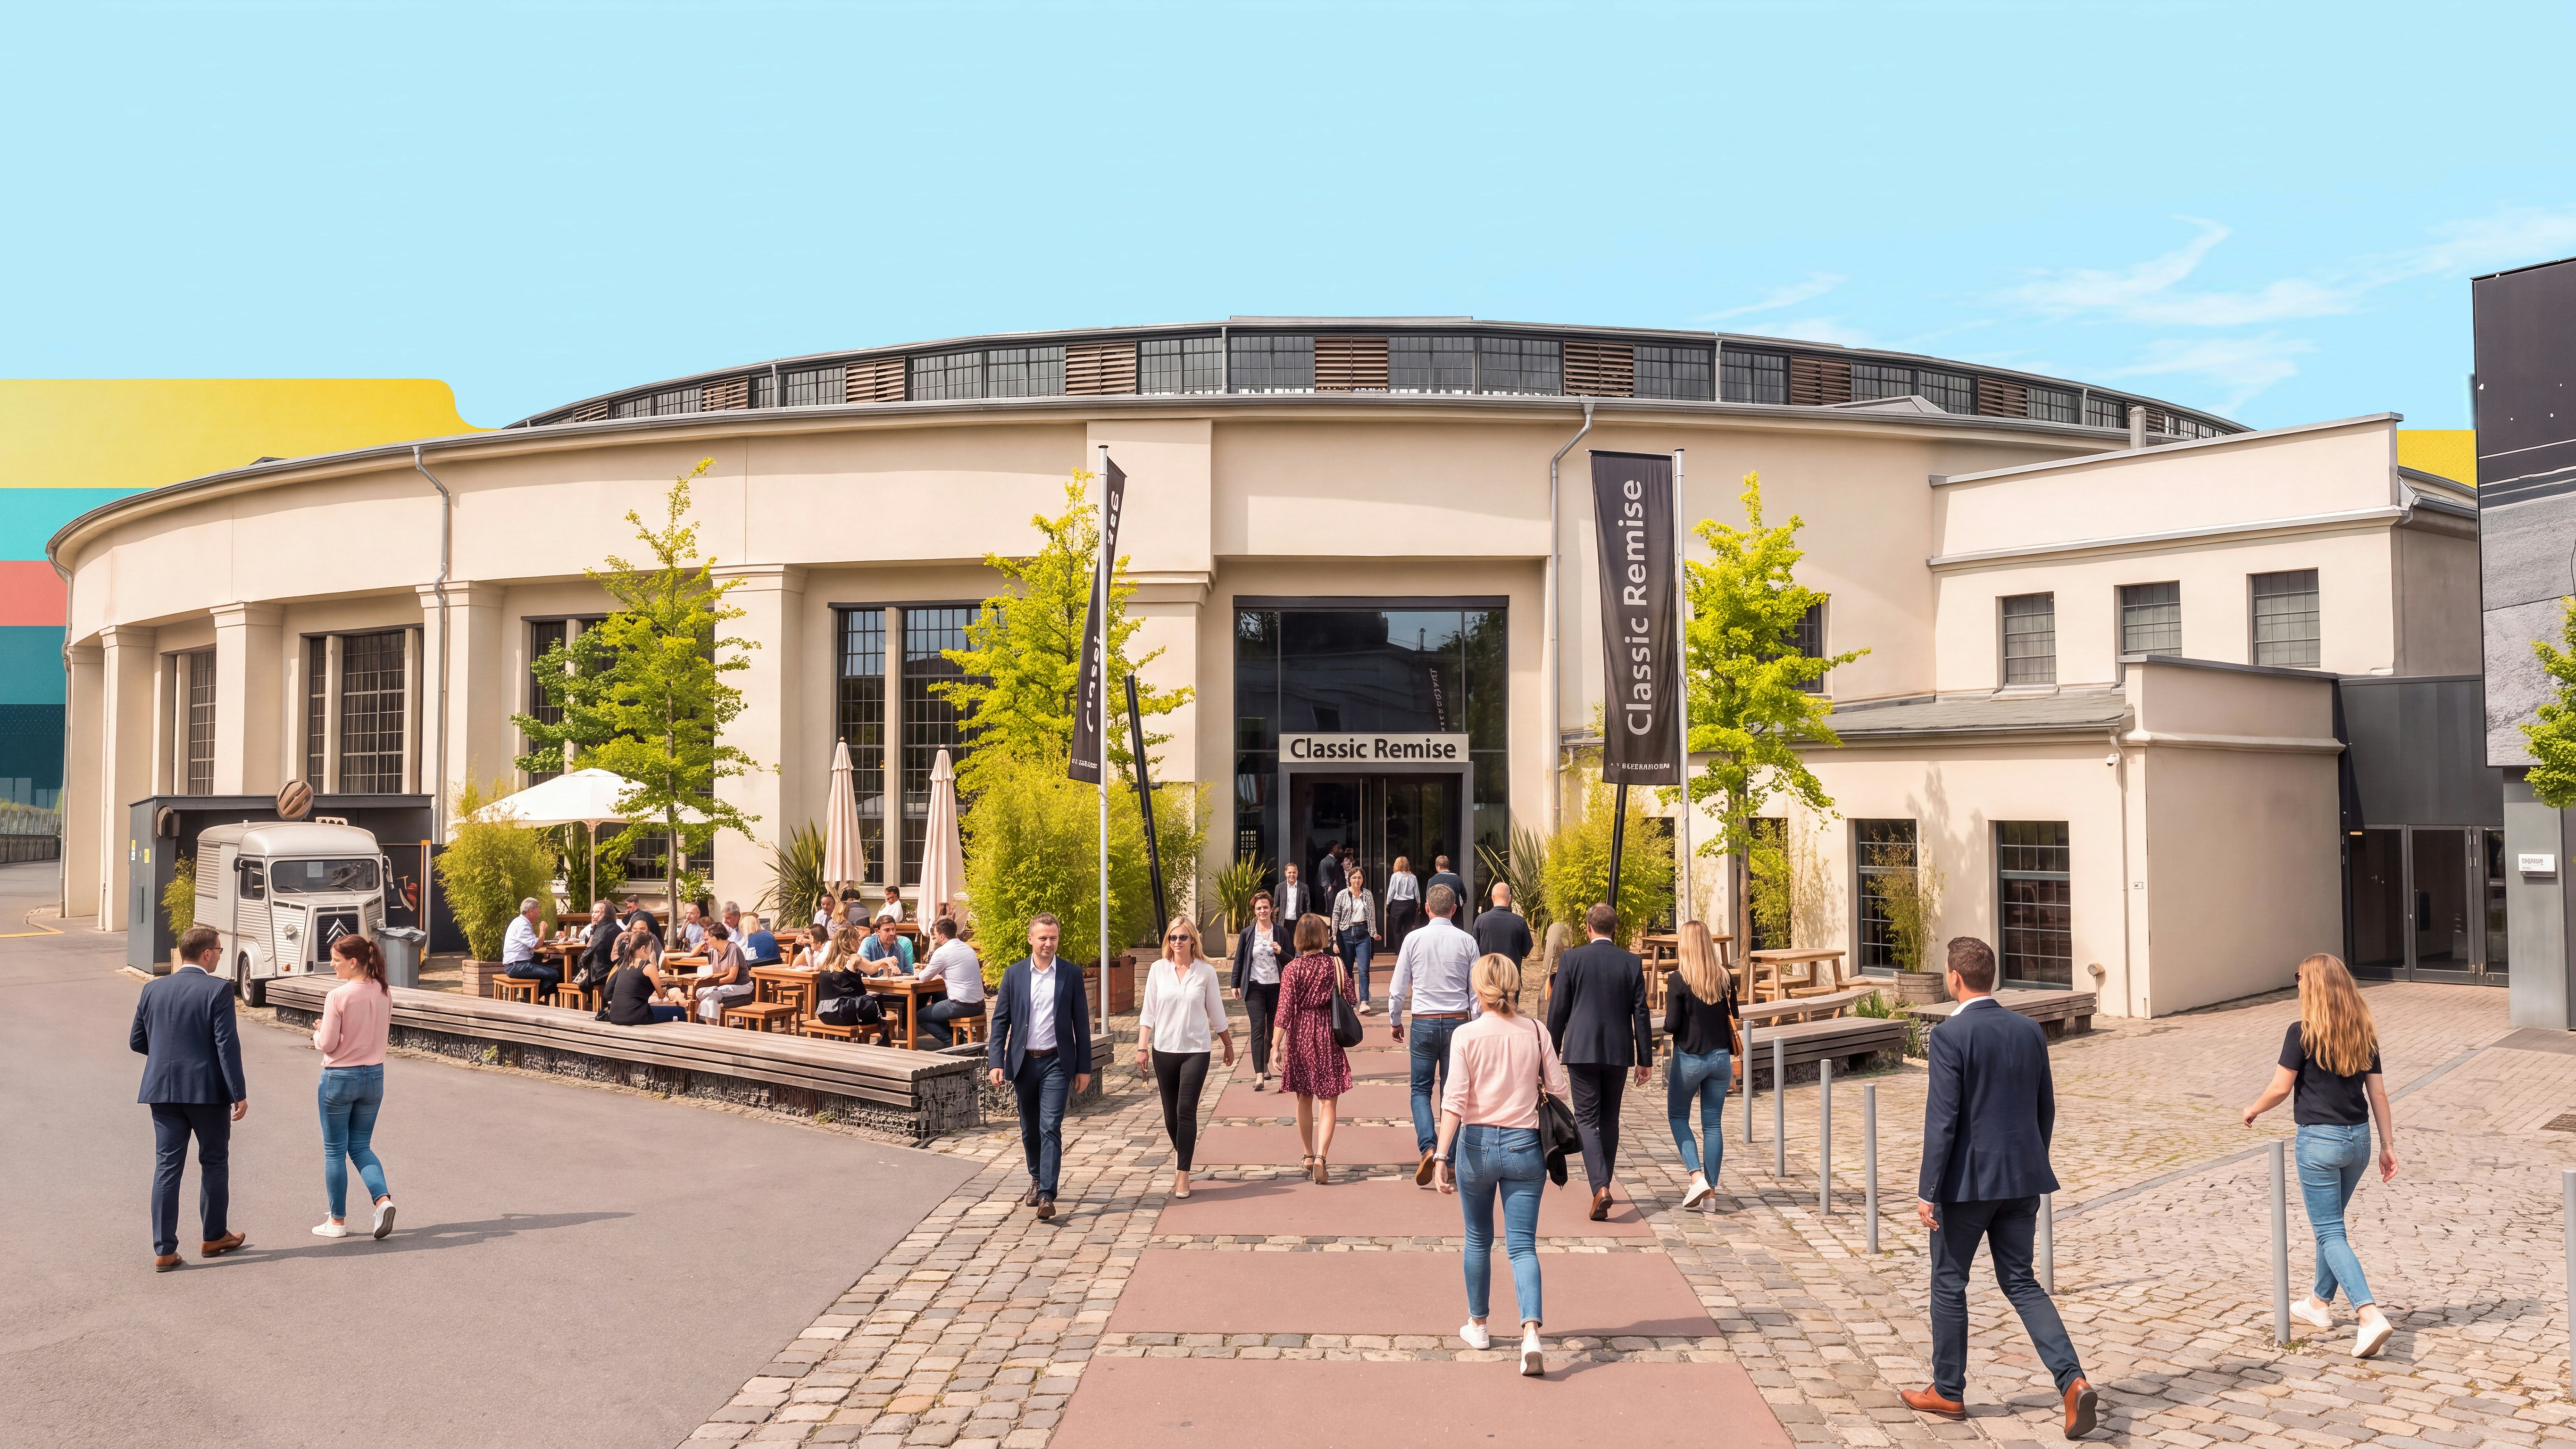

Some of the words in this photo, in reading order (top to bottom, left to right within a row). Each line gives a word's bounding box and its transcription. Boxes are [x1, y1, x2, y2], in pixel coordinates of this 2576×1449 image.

[1618, 480, 1647, 606] Remise
[1625, 617, 1652, 735] Classic
[1290, 738, 1367, 758] Classic
[1374, 738, 1456, 758] Remise
